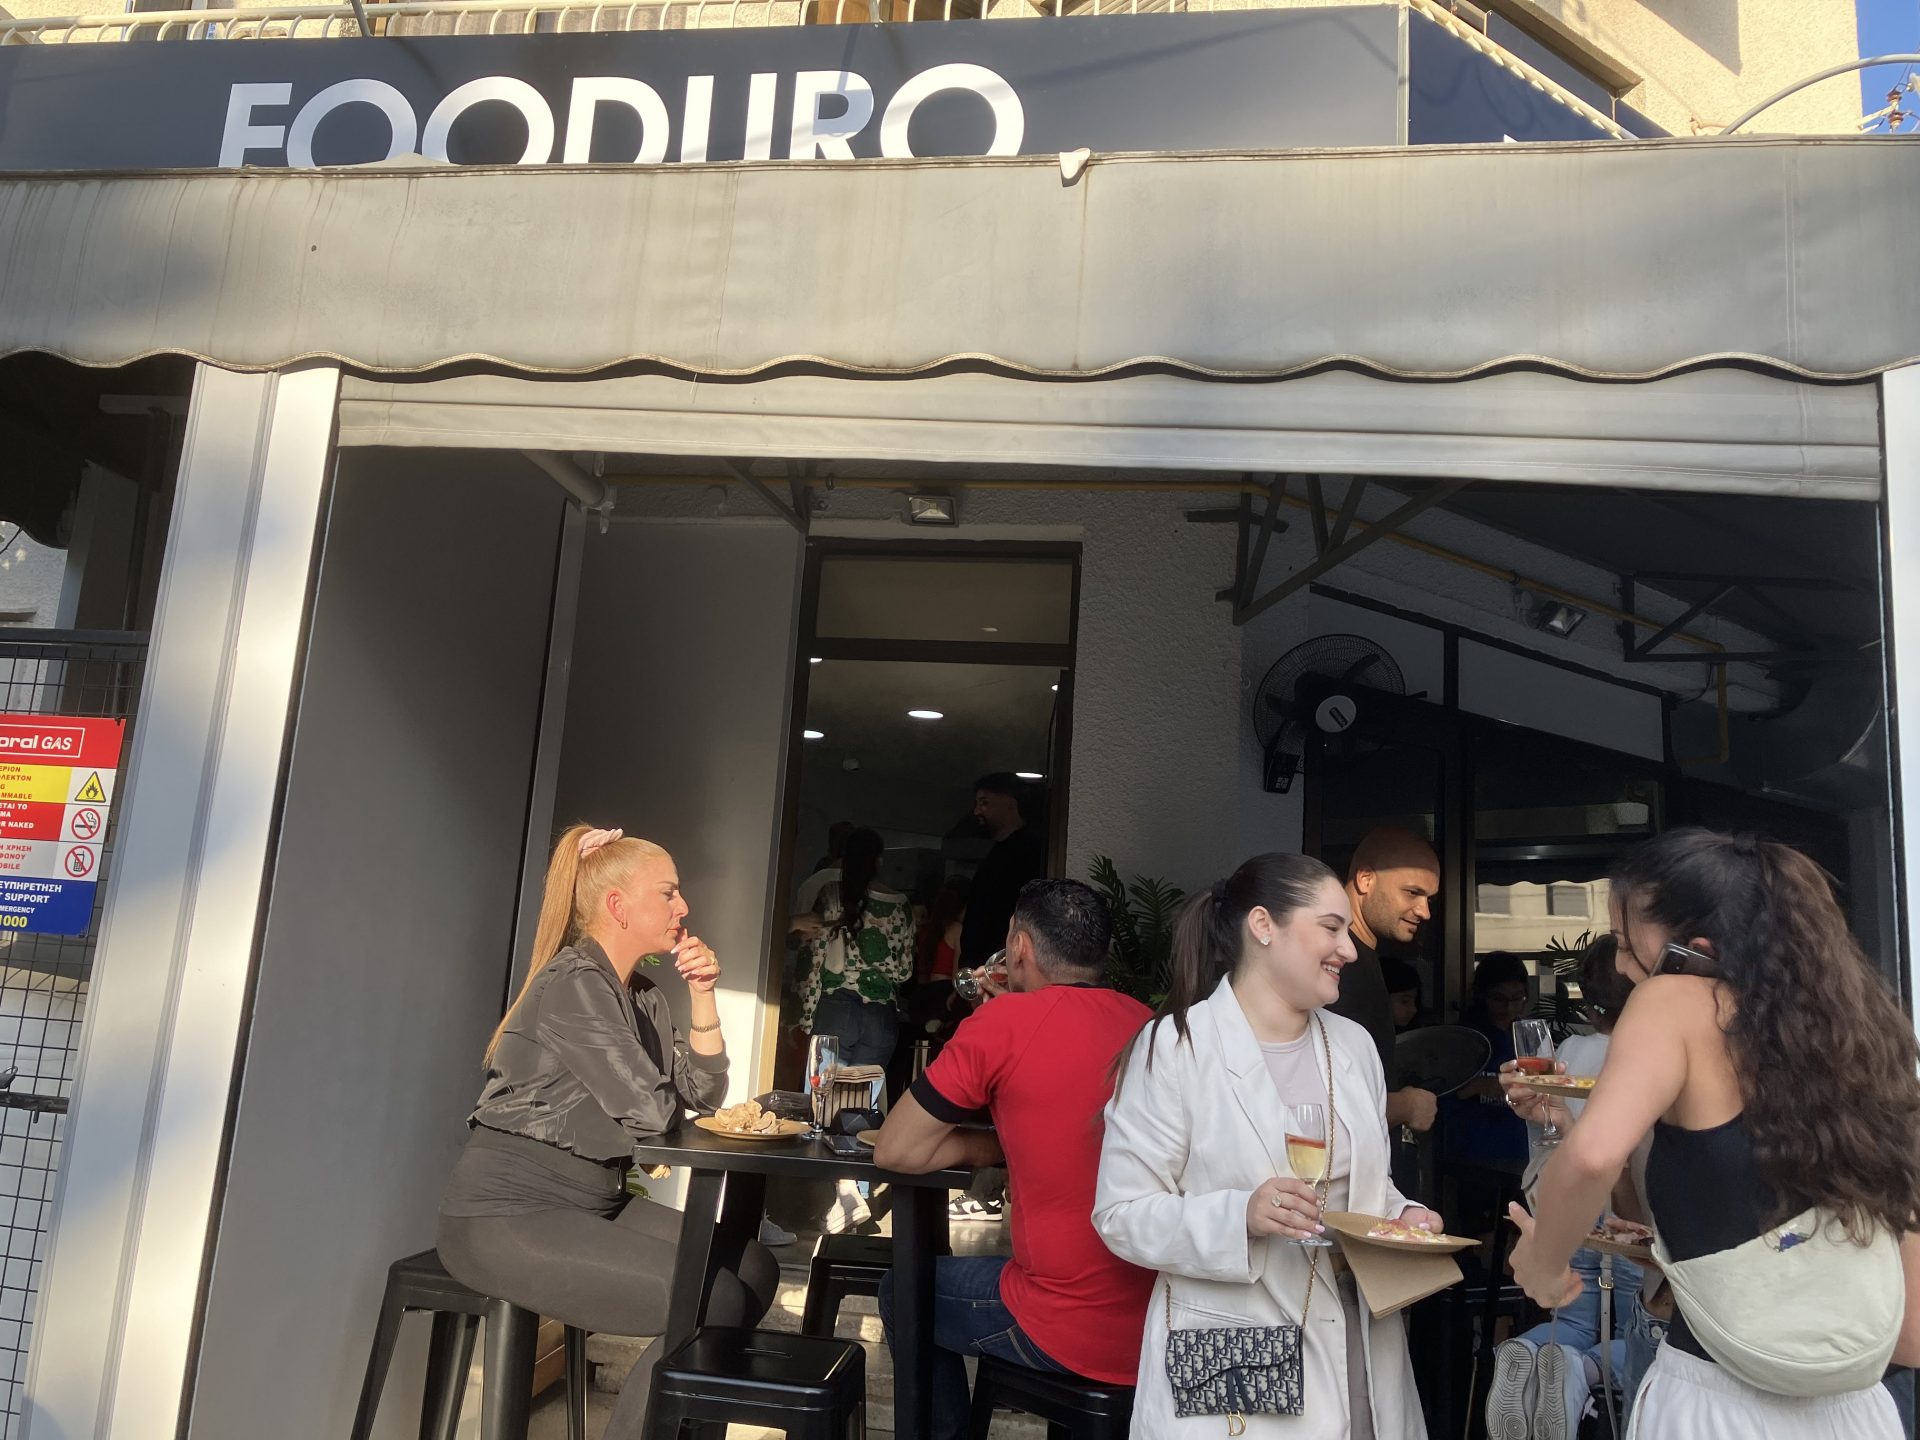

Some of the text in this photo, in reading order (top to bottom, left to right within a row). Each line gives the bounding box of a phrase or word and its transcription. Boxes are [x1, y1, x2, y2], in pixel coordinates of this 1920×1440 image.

[217, 62, 1025, 168] FOODURO
[41, 736, 72, 750] GAS
[4, 893, 50, 903] SUPPORT
